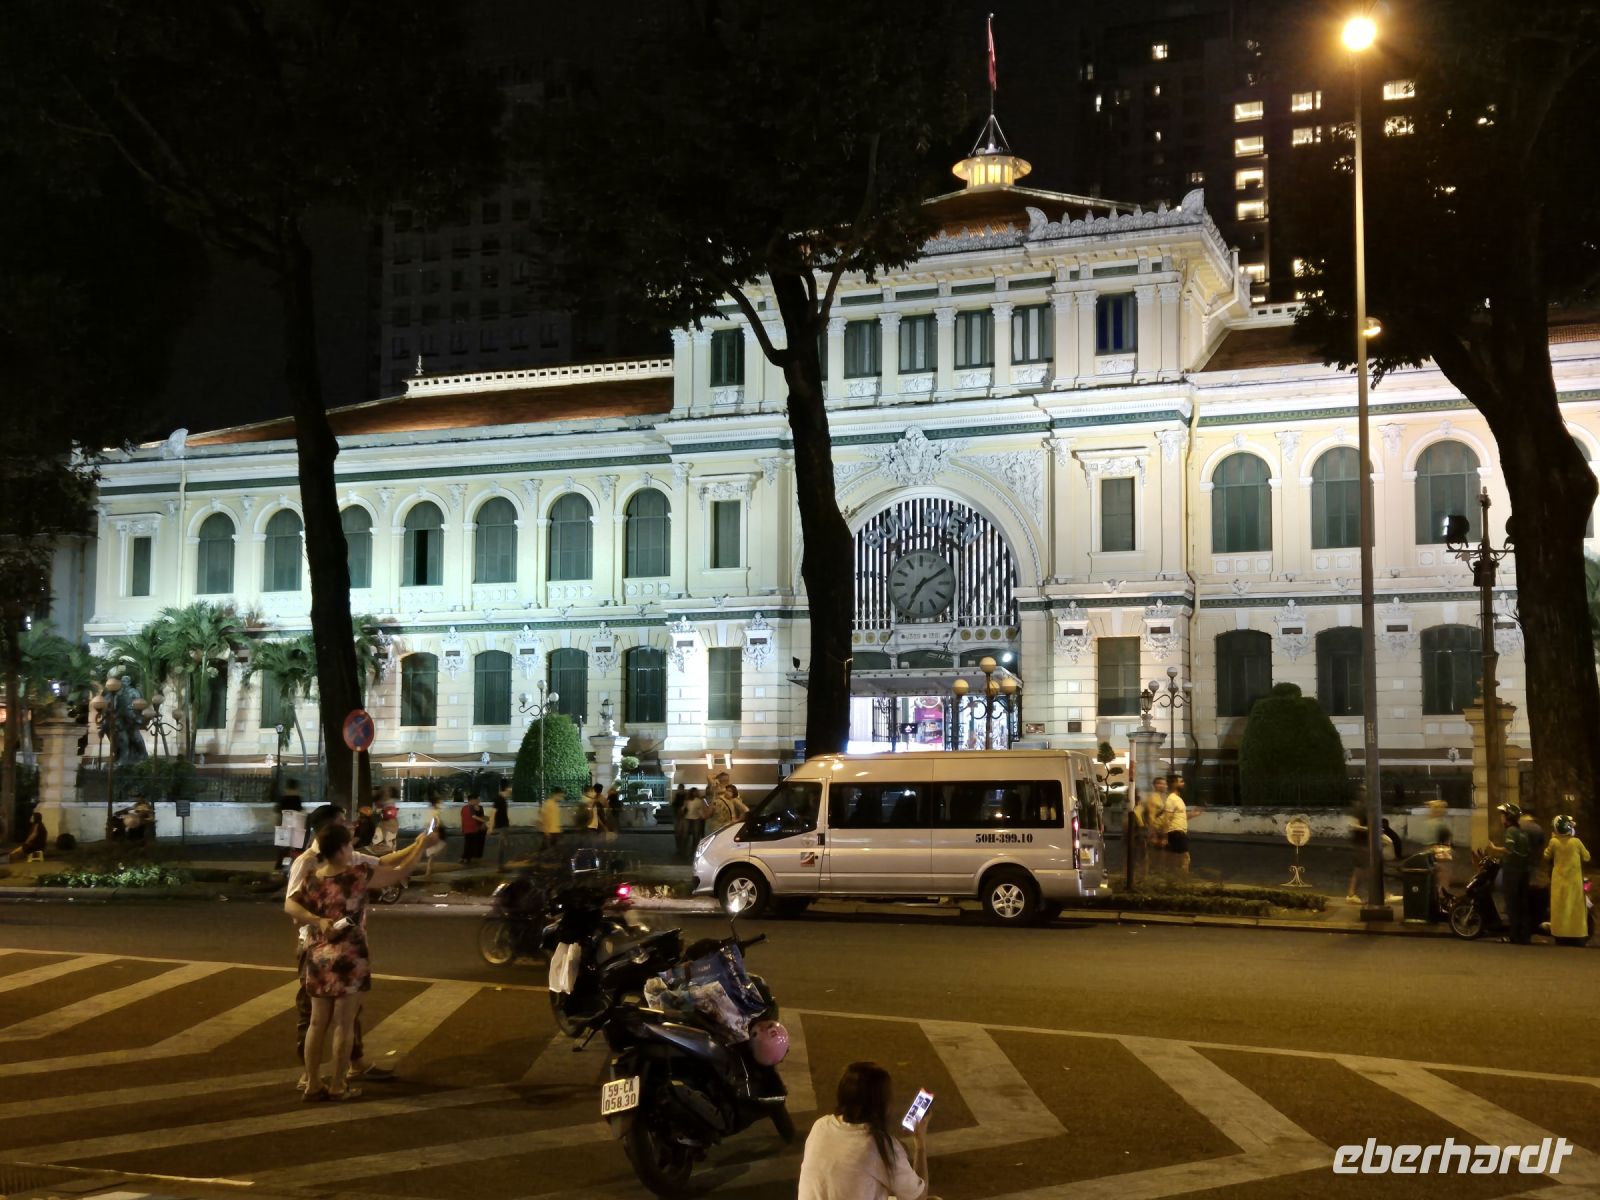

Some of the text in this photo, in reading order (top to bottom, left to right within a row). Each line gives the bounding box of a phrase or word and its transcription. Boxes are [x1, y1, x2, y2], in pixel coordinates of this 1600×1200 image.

[975, 832, 1034, 844] 50H-399.10
[608, 1080, 634, 1098] 59-CA
[604, 1093, 636, 1111] 058.30
